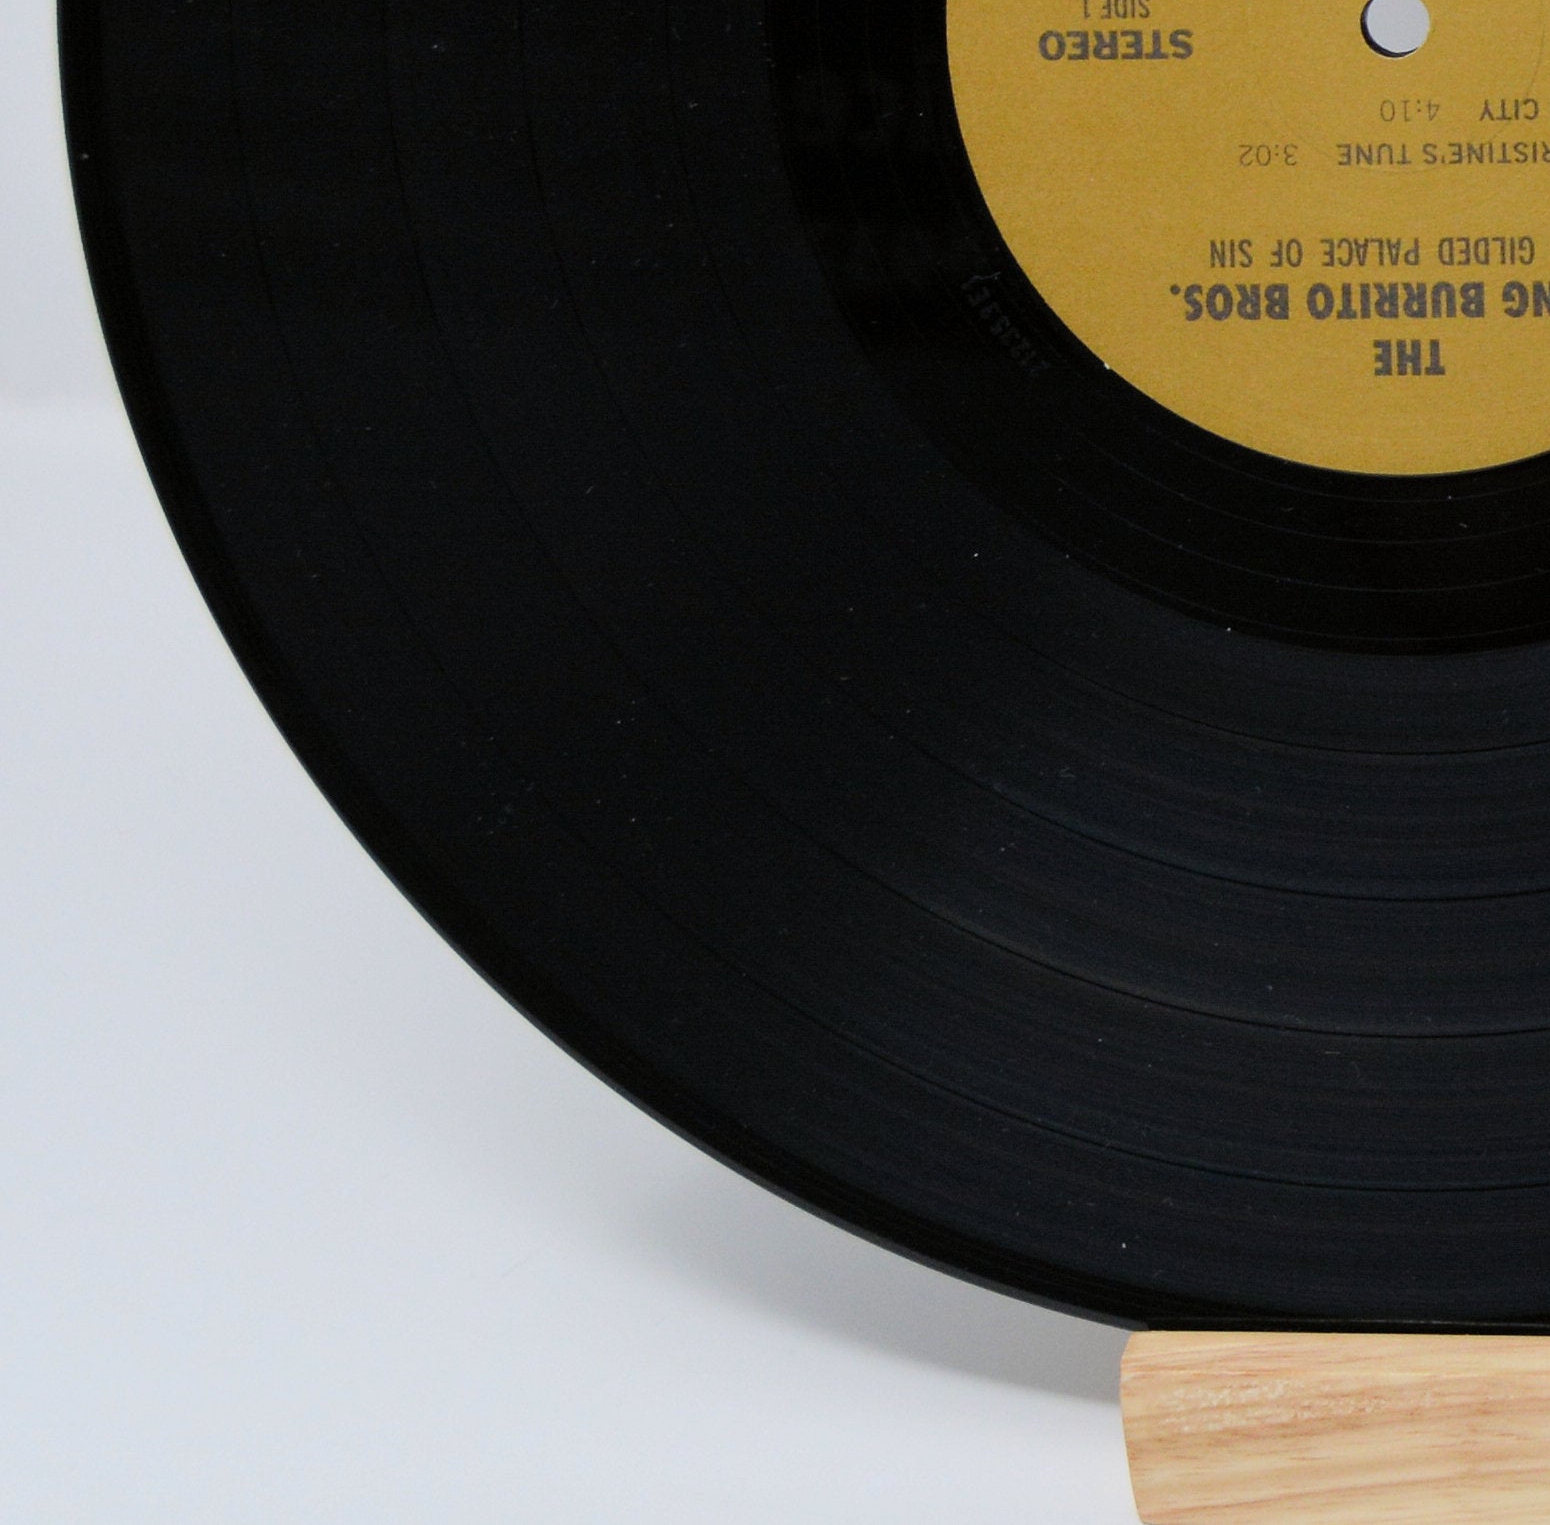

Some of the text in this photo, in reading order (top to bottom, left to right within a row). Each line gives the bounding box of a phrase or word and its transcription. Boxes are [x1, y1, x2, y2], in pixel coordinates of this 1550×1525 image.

[1037, 28, 1194, 62] STEREO
[1379, 99, 1441, 123] 4:10
[1478, 96, 1540, 123] CITY
[1238, 143, 1299, 167] 3:02
[1335, 142, 1413, 167] TUNE
[1209, 238, 1254, 270] SIN
[1269, 237, 1304, 269] OF
[1319, 236, 1421, 268] PALACE
[1437, 235, 1536, 267] GILDED
[1169, 282, 1291, 322] BROS.
[1305, 280, 1486, 321] BURRITO
[1372, 338, 1447, 377] THE
